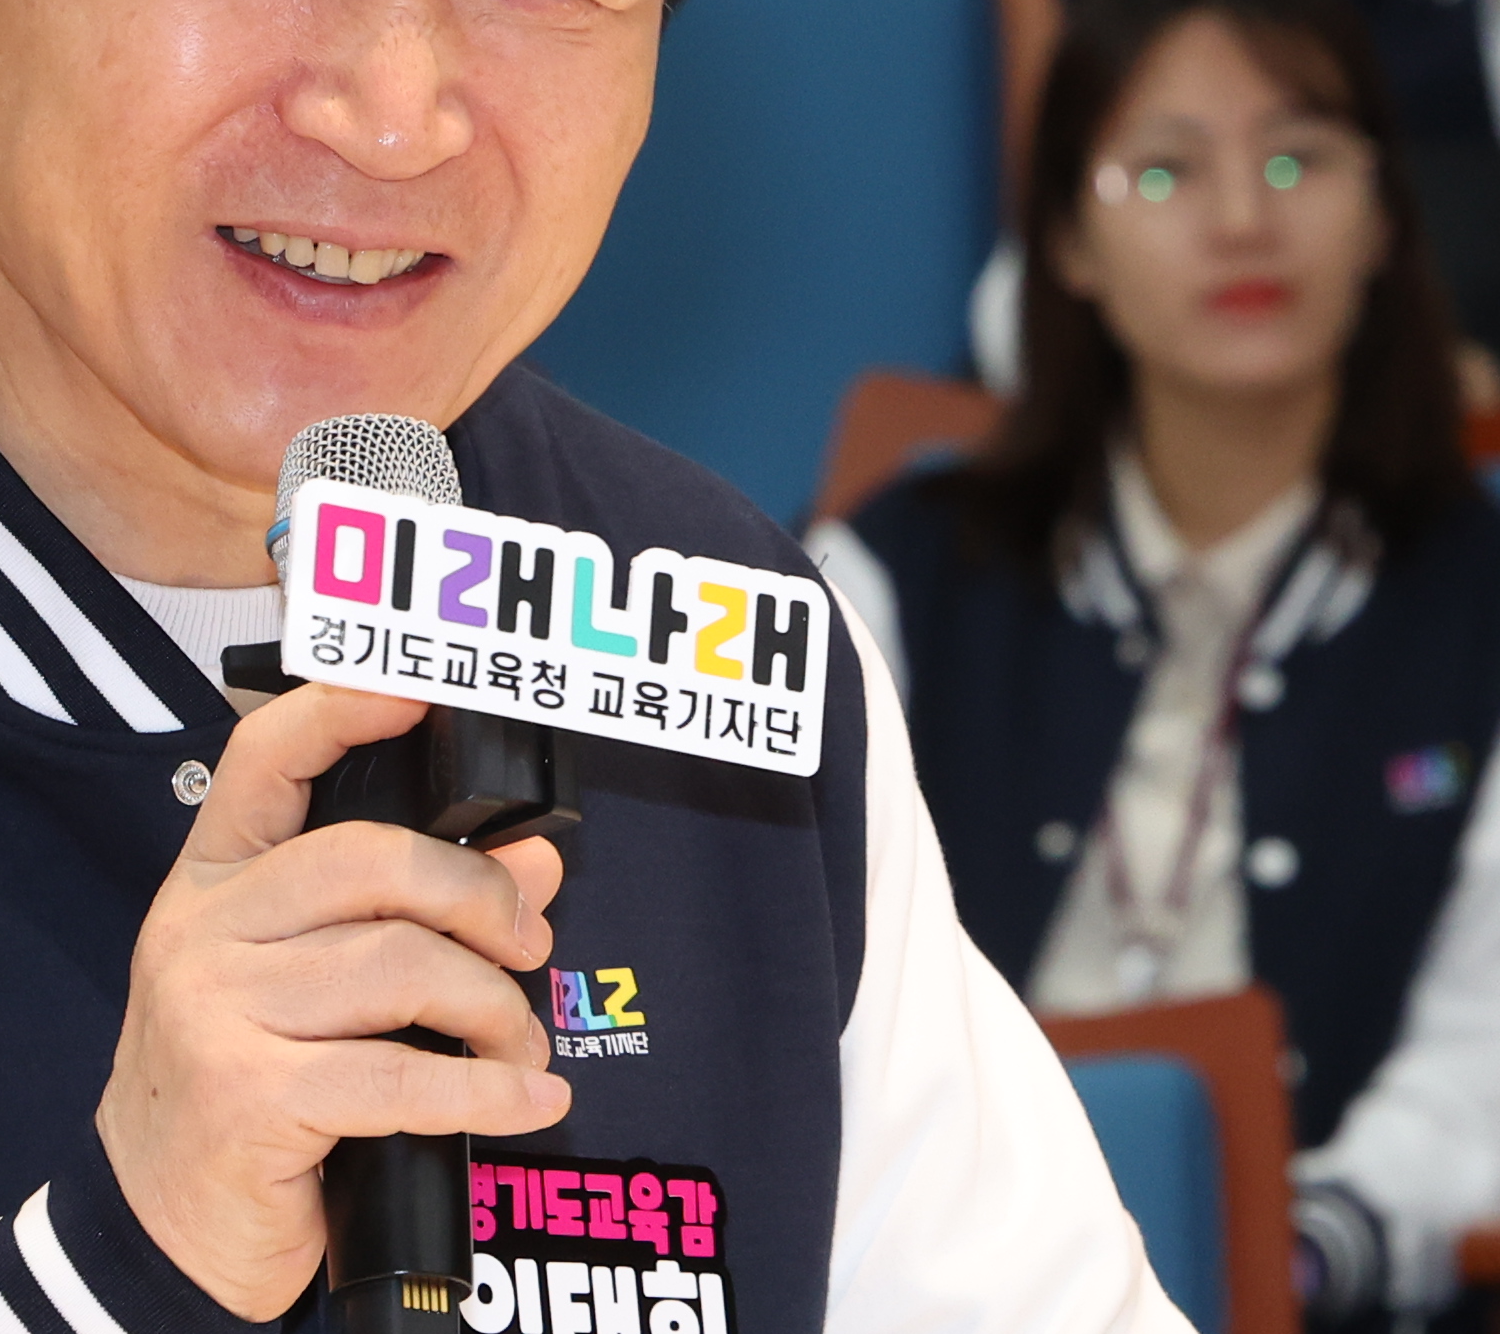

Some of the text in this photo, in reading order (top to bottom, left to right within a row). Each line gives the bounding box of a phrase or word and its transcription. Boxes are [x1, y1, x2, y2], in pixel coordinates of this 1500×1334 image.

[313, 502, 810, 693] 미래나래
[309, 613, 803, 757] 경기도교육청 교육기자단
[574, 1031, 650, 1058] 교육기자단
